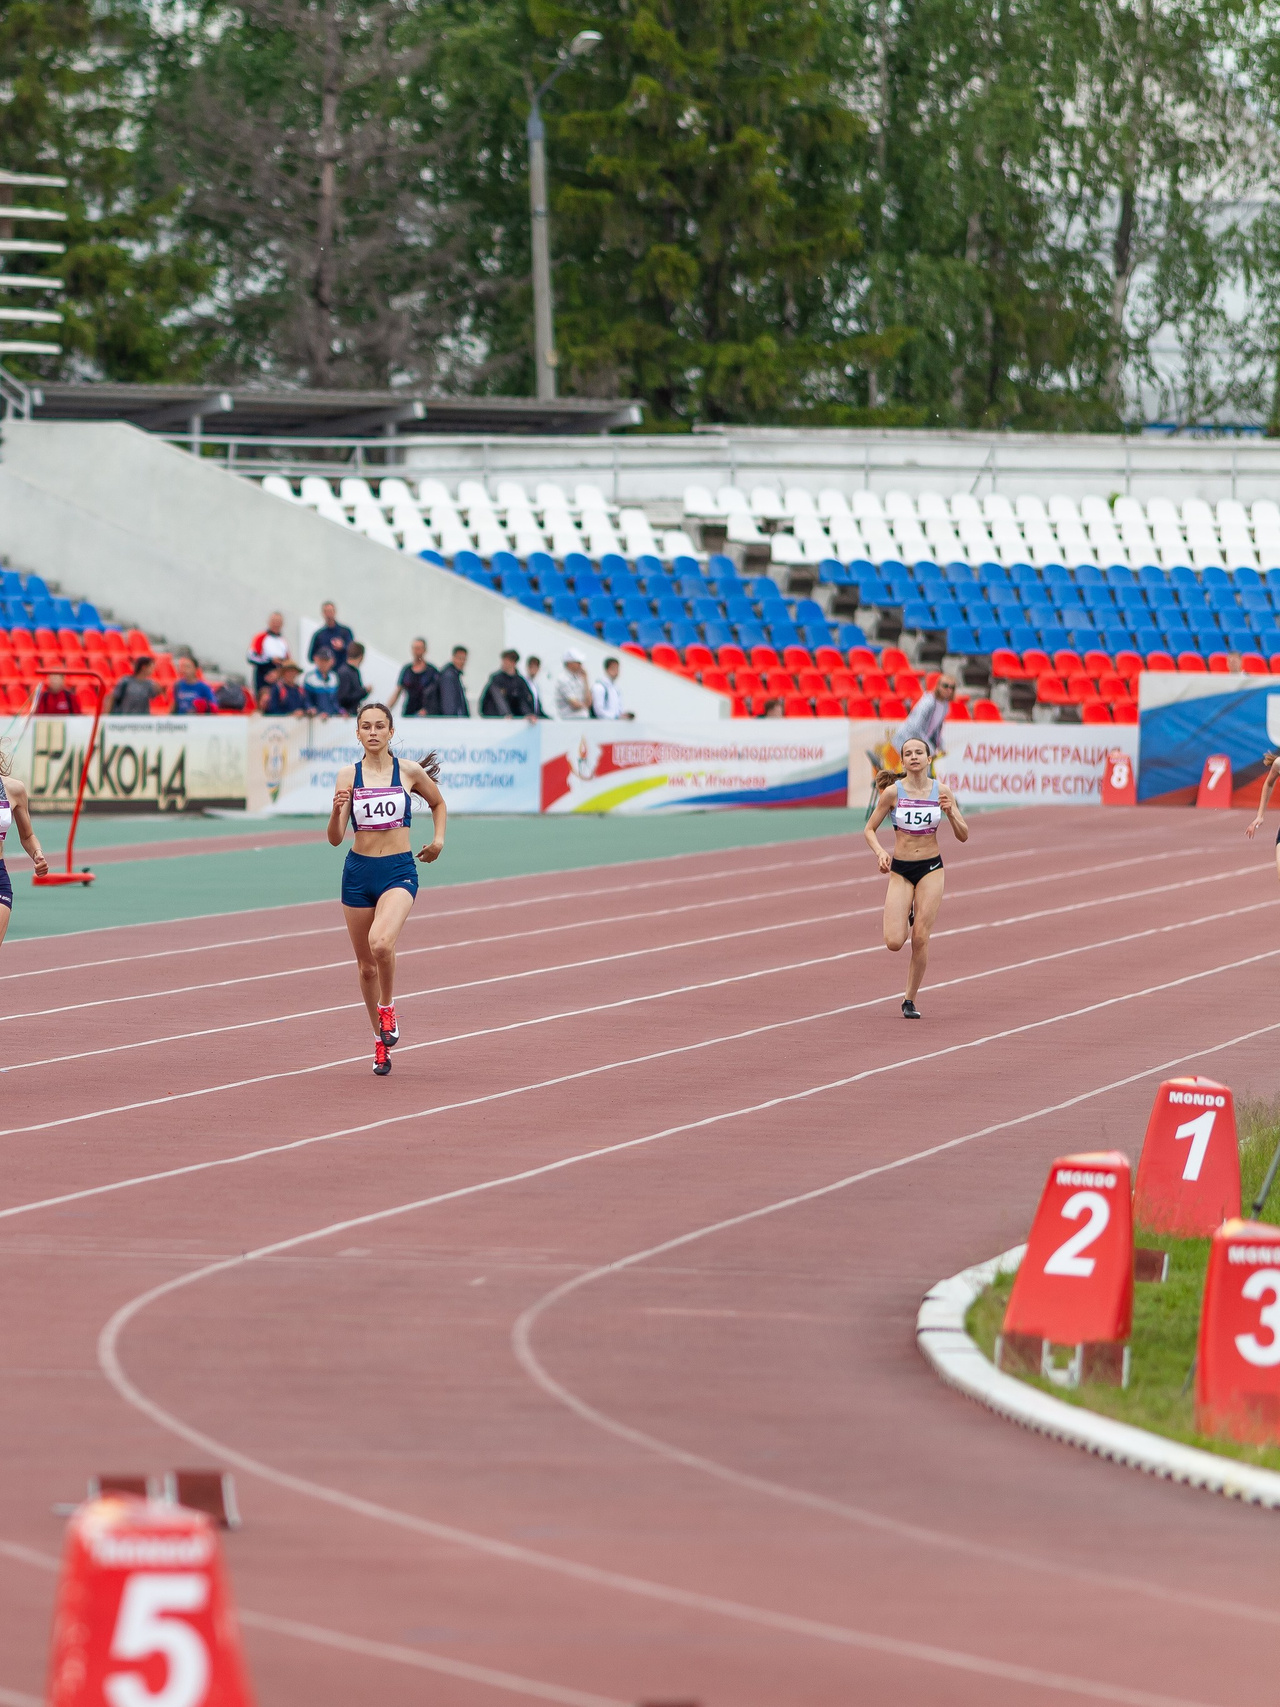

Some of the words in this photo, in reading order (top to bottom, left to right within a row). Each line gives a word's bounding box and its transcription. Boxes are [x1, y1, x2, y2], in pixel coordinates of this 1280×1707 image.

[937, 771, 1035, 794] УВАШСКОЙ
[1110, 763, 1129, 790] 8
[1207, 764, 1227, 791] 7
[362, 801, 396, 818] 140
[904, 811, 932, 825] 154
[1169, 1091, 1226, 1107] MONDO
[1174, 1110, 1217, 1182] 1
[1055, 1169, 1118, 1189] MONDO
[1043, 1190, 1111, 1278] 2
[1234, 1267, 1280, 1367] 3
[102, 1570, 211, 1707] 5
